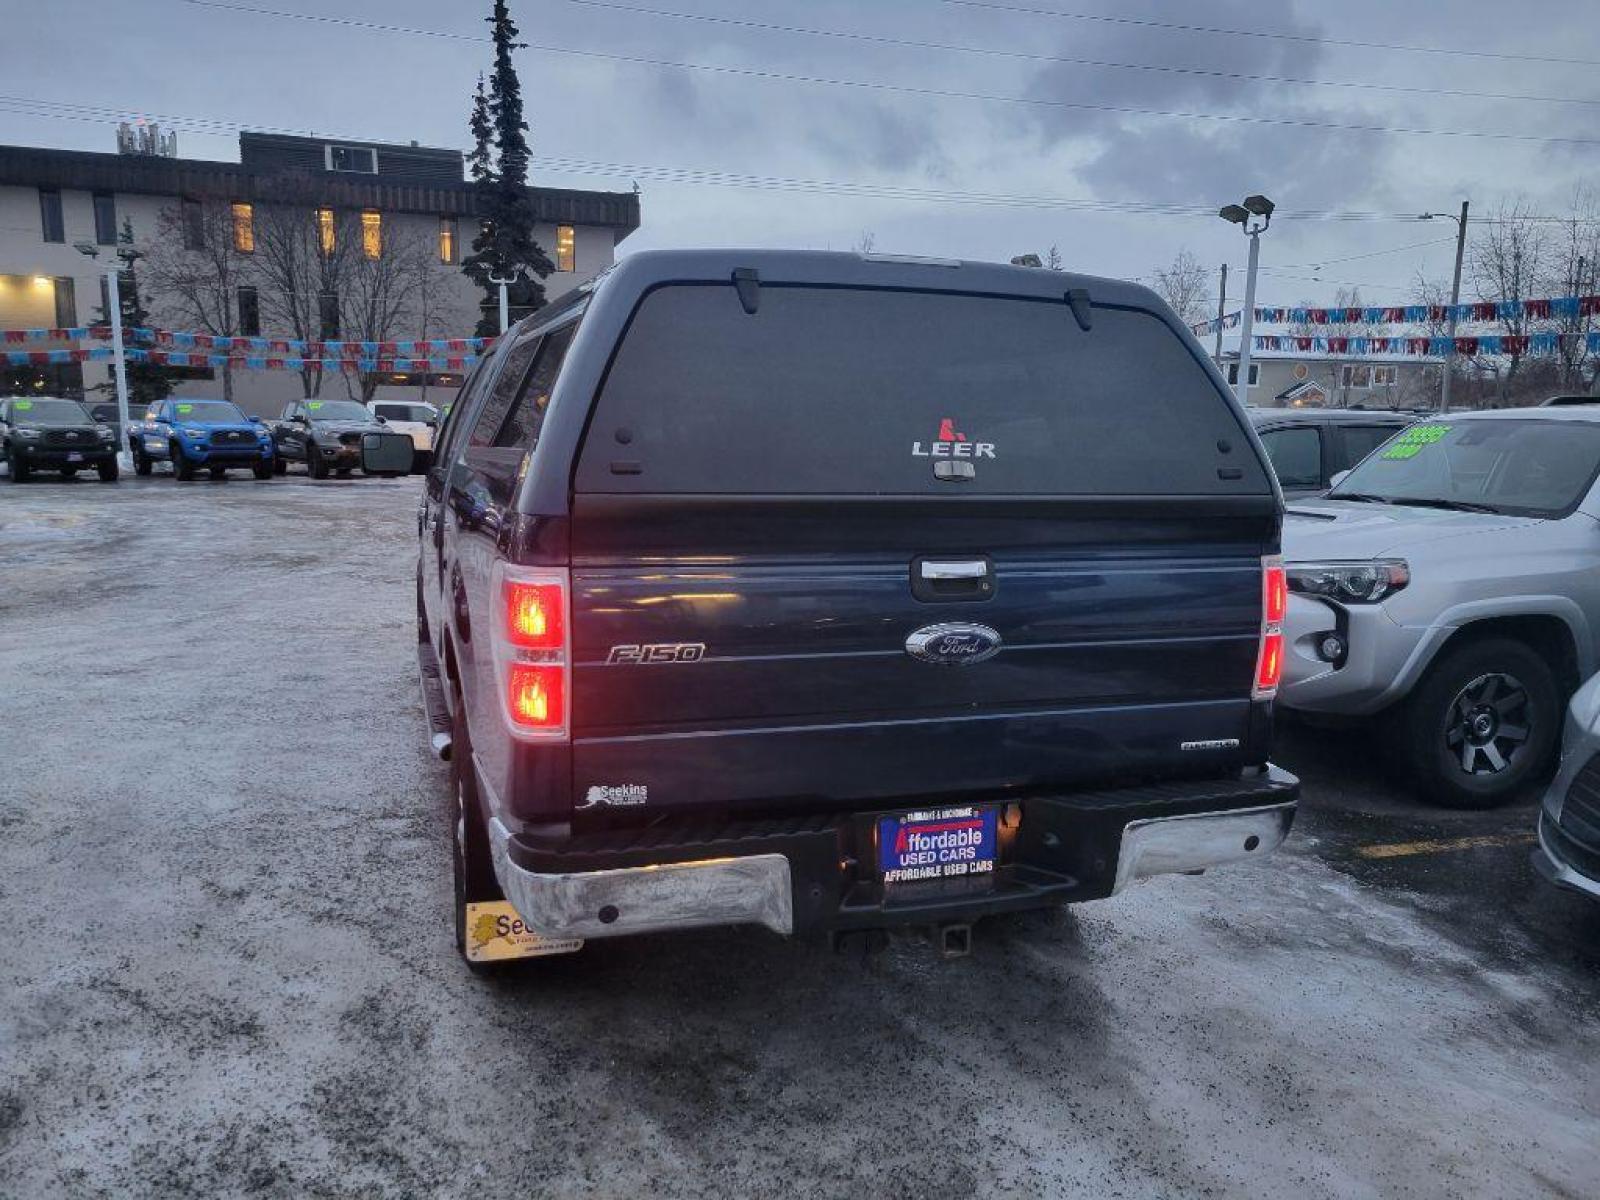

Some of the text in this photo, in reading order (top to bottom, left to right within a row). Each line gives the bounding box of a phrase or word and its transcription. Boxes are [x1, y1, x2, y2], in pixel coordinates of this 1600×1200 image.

[911, 441, 996, 458] LEER
[605, 643, 706, 665] F-150
[940, 635, 981, 654] Ford
[600, 784, 648, 798] Seekins
[895, 825, 982, 853] Affordable
[900, 846, 976, 866] USED CARS
[884, 860, 993, 882] AFFORDABLE USED CARS
